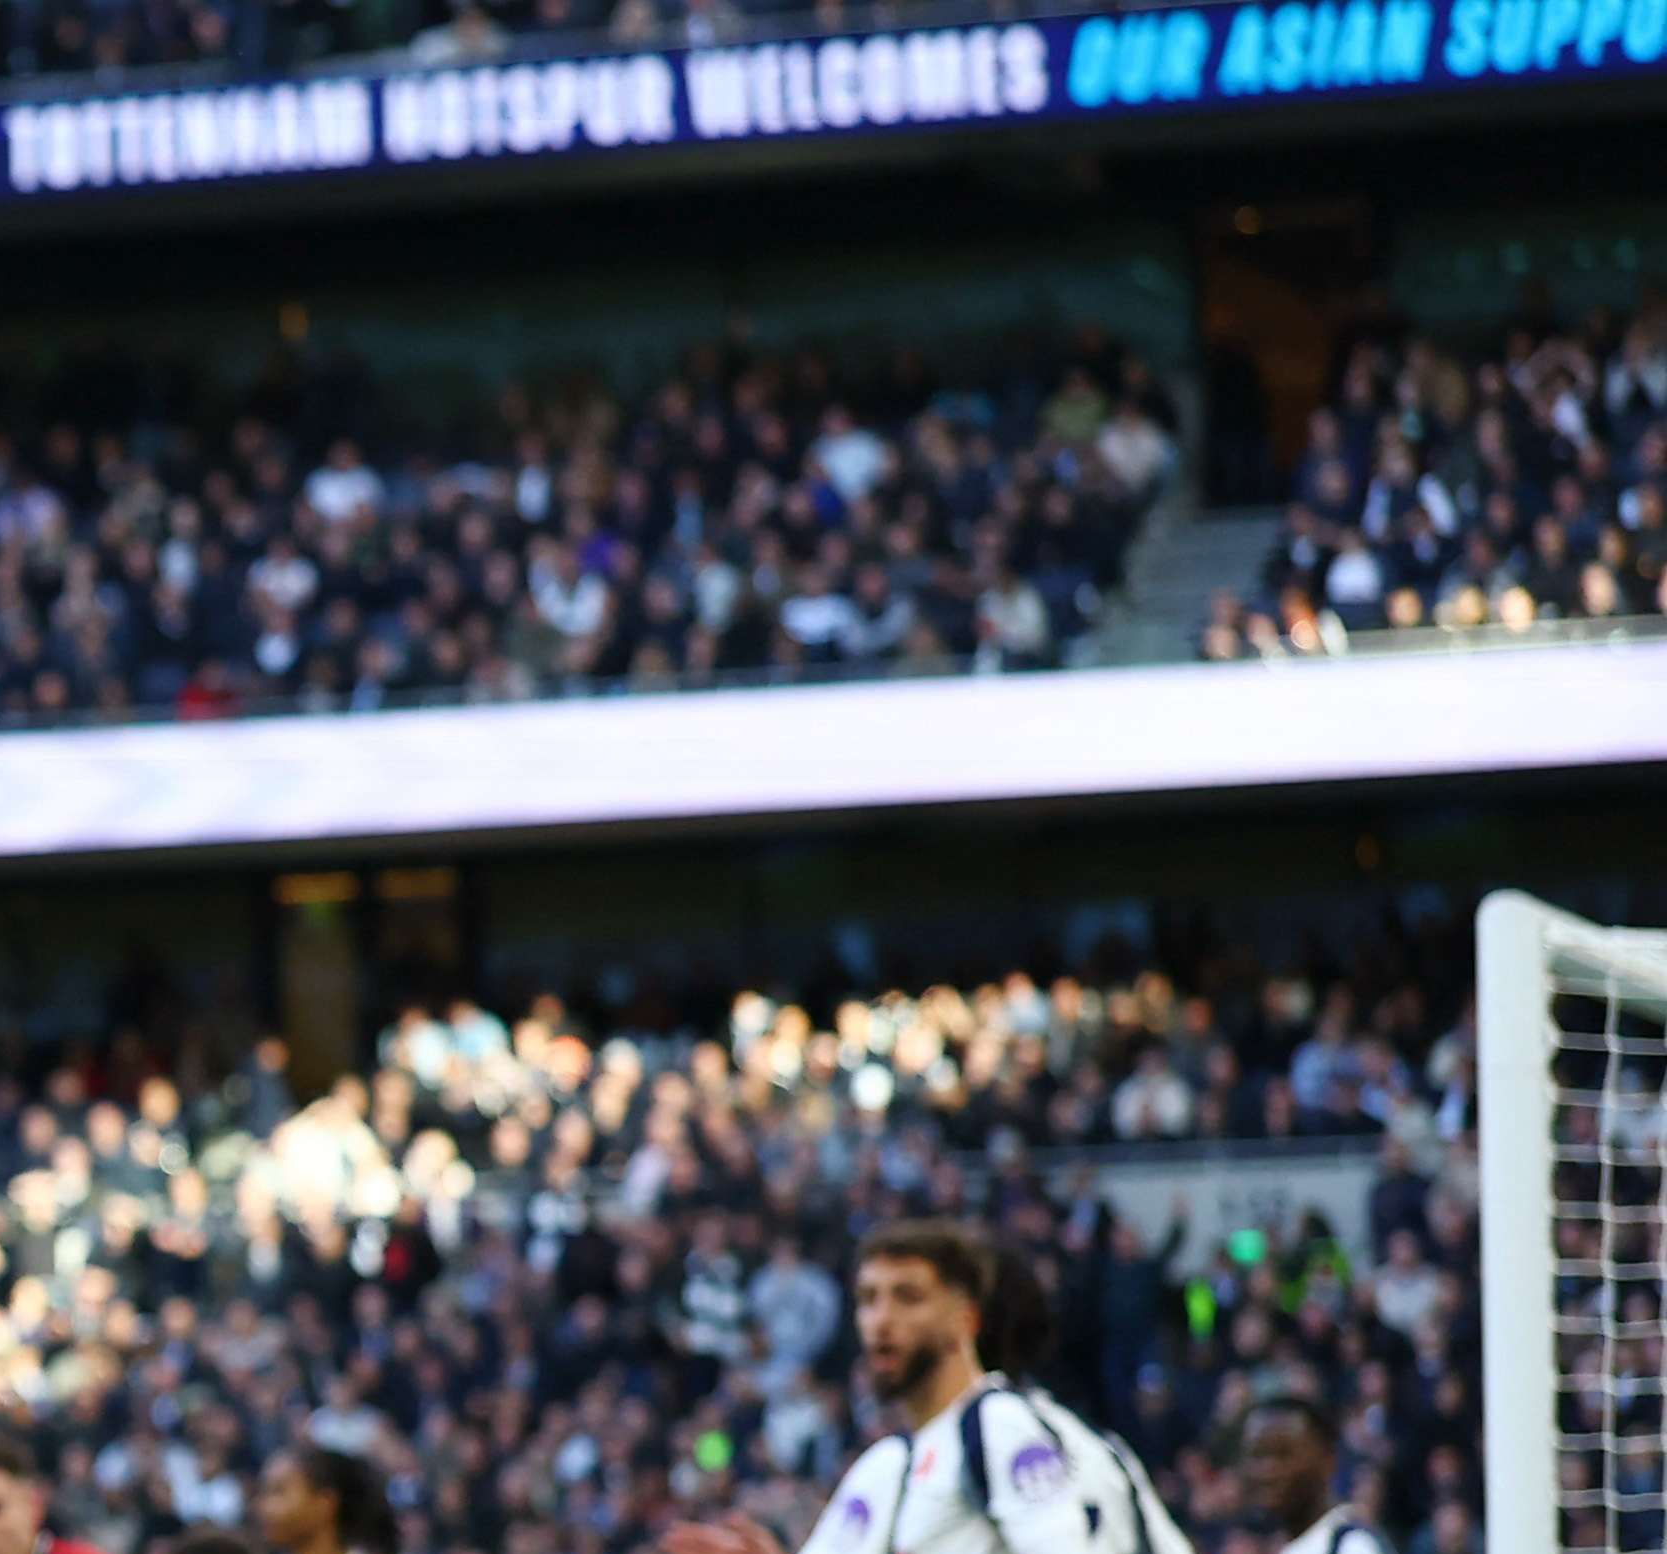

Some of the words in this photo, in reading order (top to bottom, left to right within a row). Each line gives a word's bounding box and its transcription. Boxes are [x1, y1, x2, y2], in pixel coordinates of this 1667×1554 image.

[5, 79, 374, 192] TOTTENHAM
[383, 52, 674, 165] HOTSPUR
[684, 24, 1050, 140] WELCOMES
[1068, 14, 1210, 107] OUR
[1217, 1, 1433, 96] ASIAN
